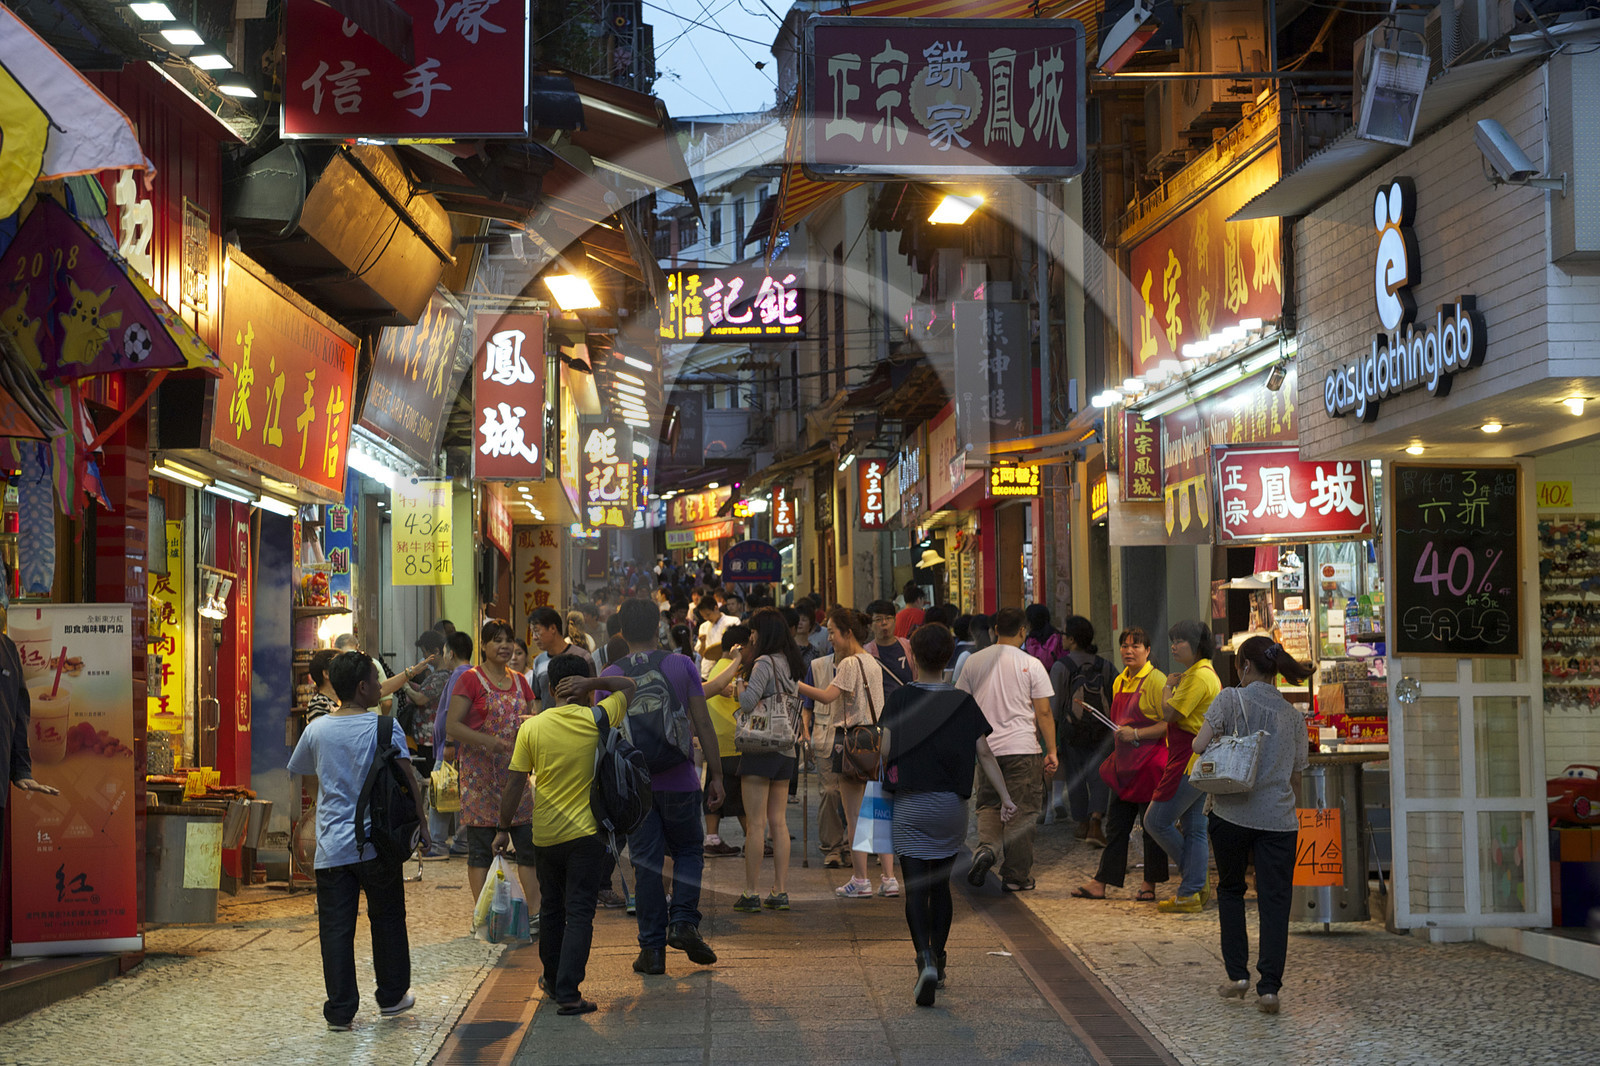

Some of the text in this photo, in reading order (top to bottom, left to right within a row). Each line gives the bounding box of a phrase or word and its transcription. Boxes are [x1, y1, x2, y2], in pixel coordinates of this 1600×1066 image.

[825, 38, 1070, 152] 正宗 鳳城
[923, 40, 971, 151] 餅家
[14, 245, 79, 281] 2008
[303, 321, 323, 361] HOU
[321, 334, 346, 373] KONG
[1324, 302, 1472, 418] easyclothinglab
[229, 320, 345, 478] 濠江手信
[479, 329, 538, 464] 鳳城
[992, 486, 1039, 496] EXCHANGE
[1224, 466, 1250, 526] 正宗
[1252, 462, 1365, 520] 鳳城
[1413, 541, 1503, 597] 40%
[64, 624, 125, 635] 即食海味專門店
[1402, 606, 1511, 645] SALE
